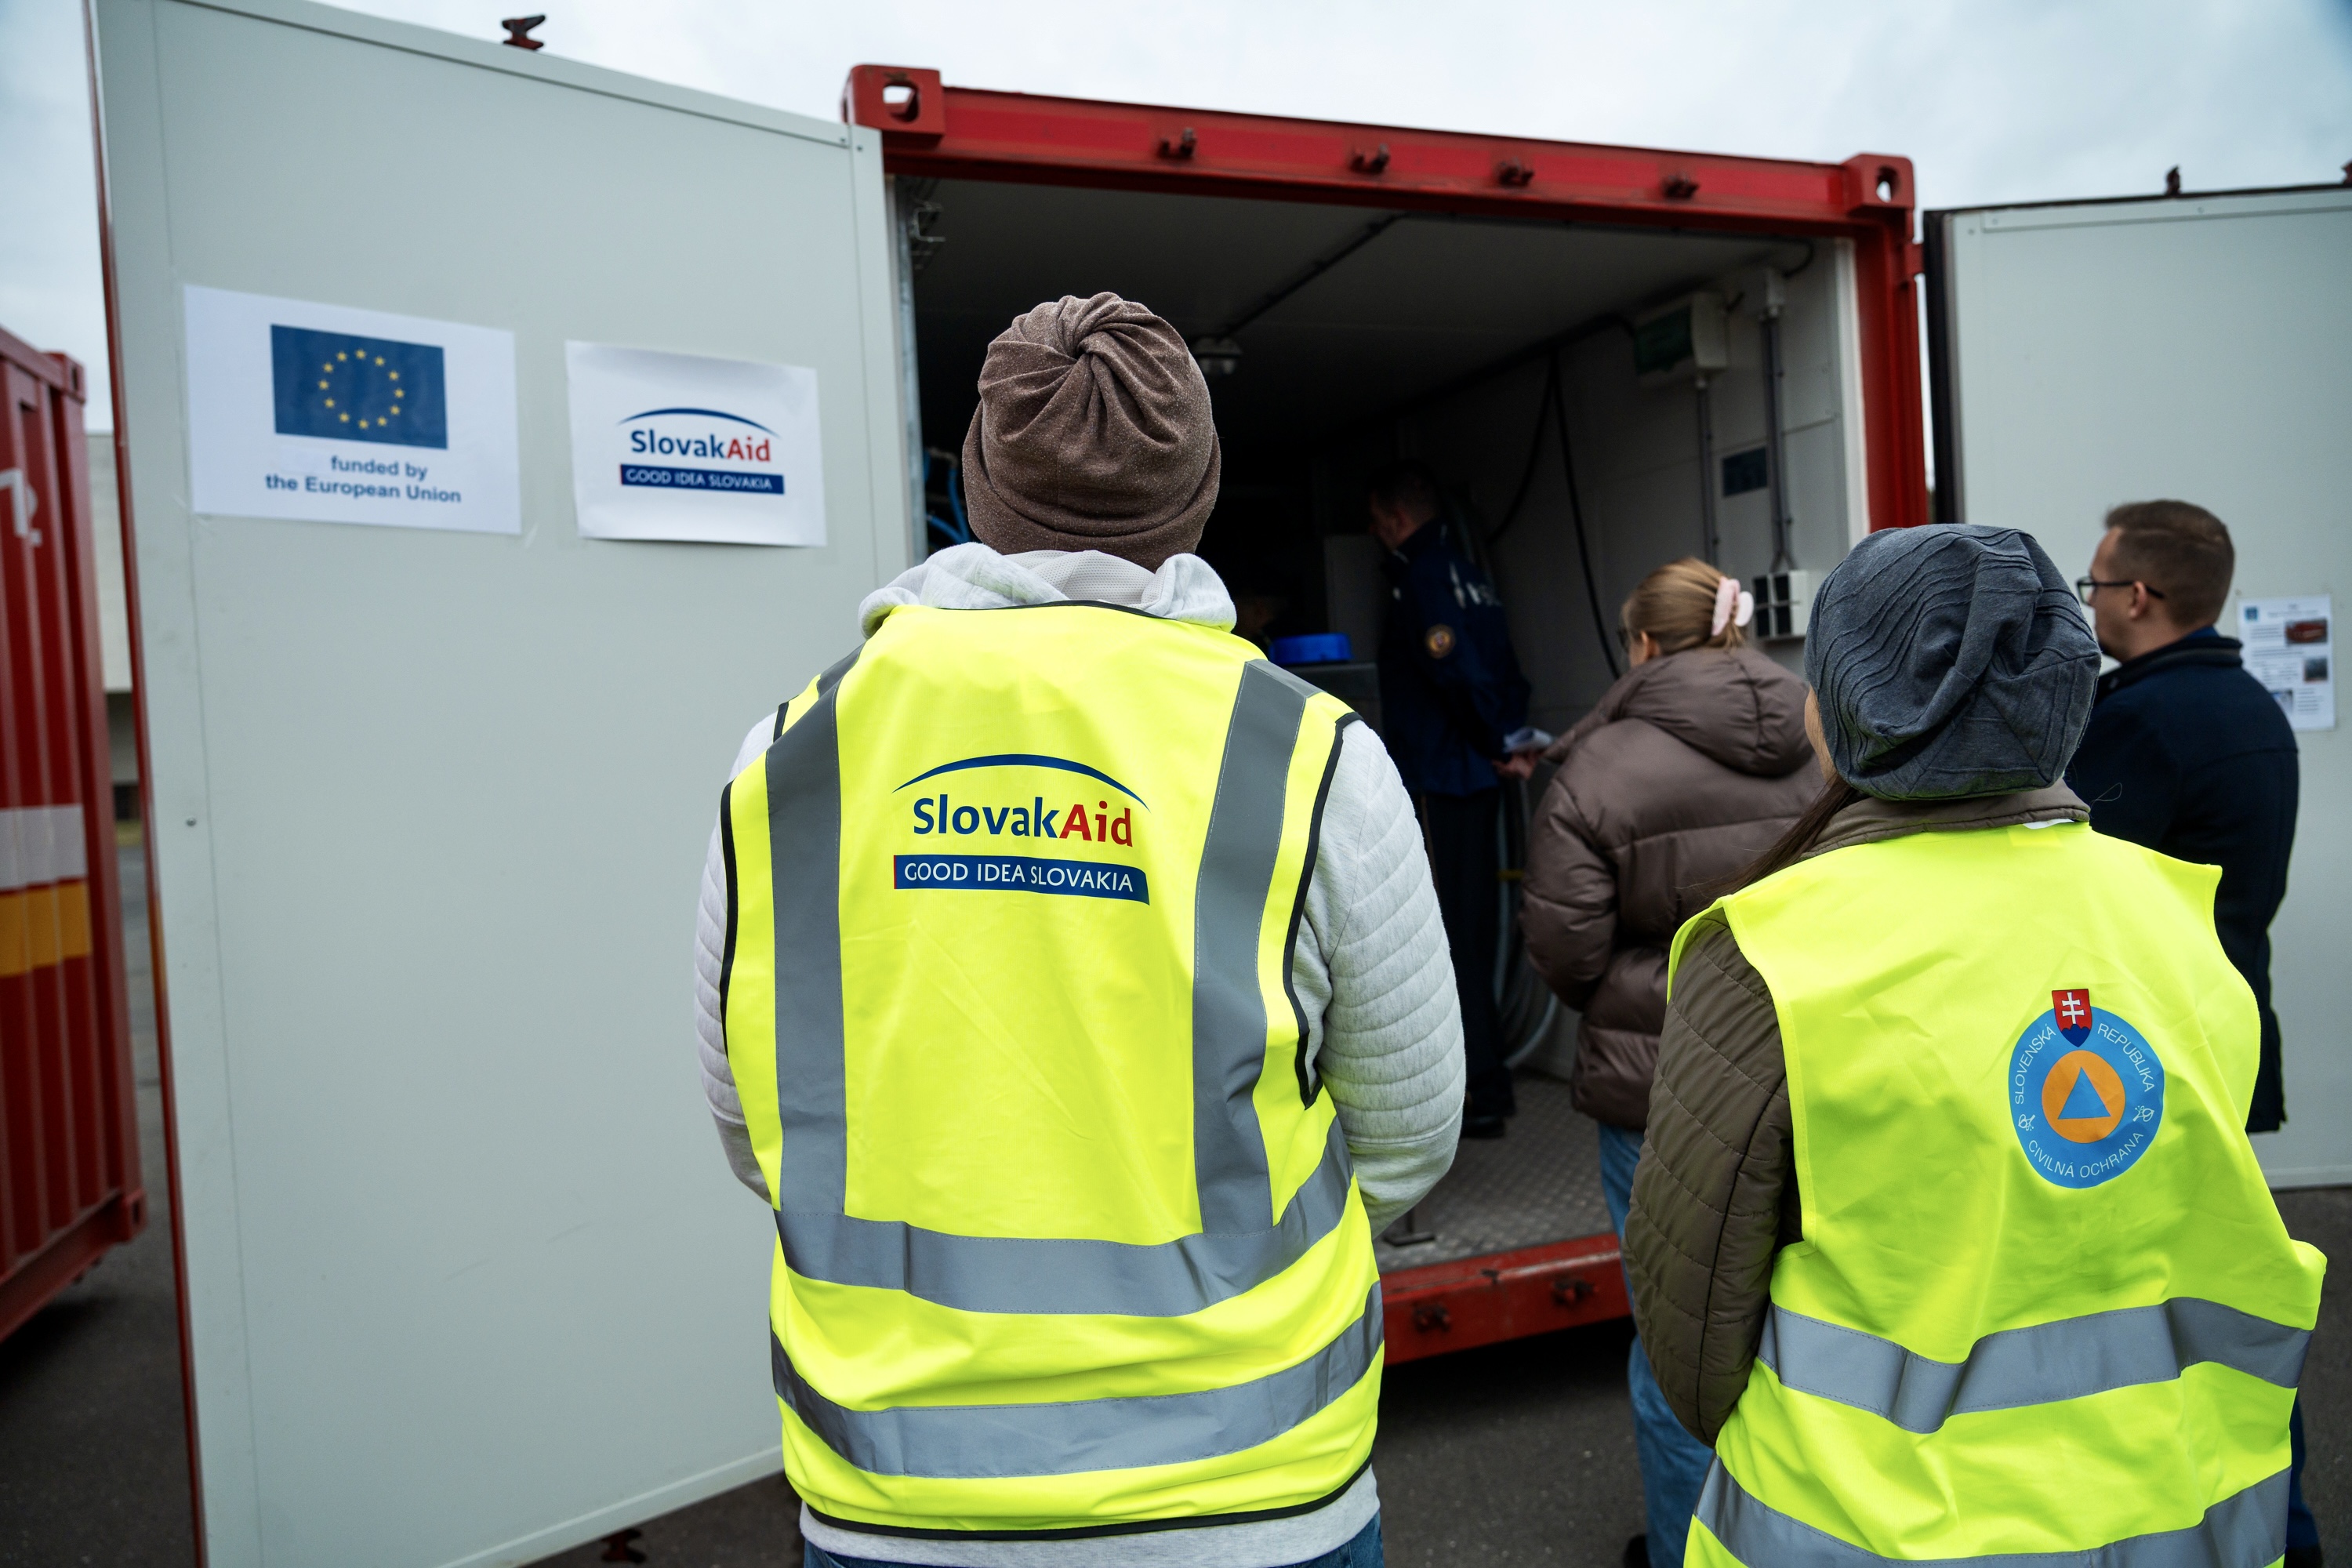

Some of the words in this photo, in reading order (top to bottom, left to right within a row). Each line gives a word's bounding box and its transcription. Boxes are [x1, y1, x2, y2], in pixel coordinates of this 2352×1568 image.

[631, 429, 771, 462] SlovakAid
[331, 456, 399, 476] funded
[405, 462, 428, 481] by
[626, 469, 671, 483] GOOD
[674, 471, 706, 486] IDEA
[709, 474, 773, 490] SLOVAKIA
[265, 474, 299, 491] the
[304, 476, 401, 499] European
[405, 485, 462, 503] Union
[913, 793, 1134, 848] SlovakAid
[904, 862, 968, 881] GOOD
[977, 863, 1025, 883] IDEA
[1030, 866, 1134, 892] SLOVAKIA
[2014, 1023, 2056, 1105] SLOVENSKÁ
[2096, 1023, 2155, 1092] REPUBLIKA
[2027, 1139, 2074, 1178] CIVILNÁ
[2079, 1131, 2144, 1178] OCHRANA
